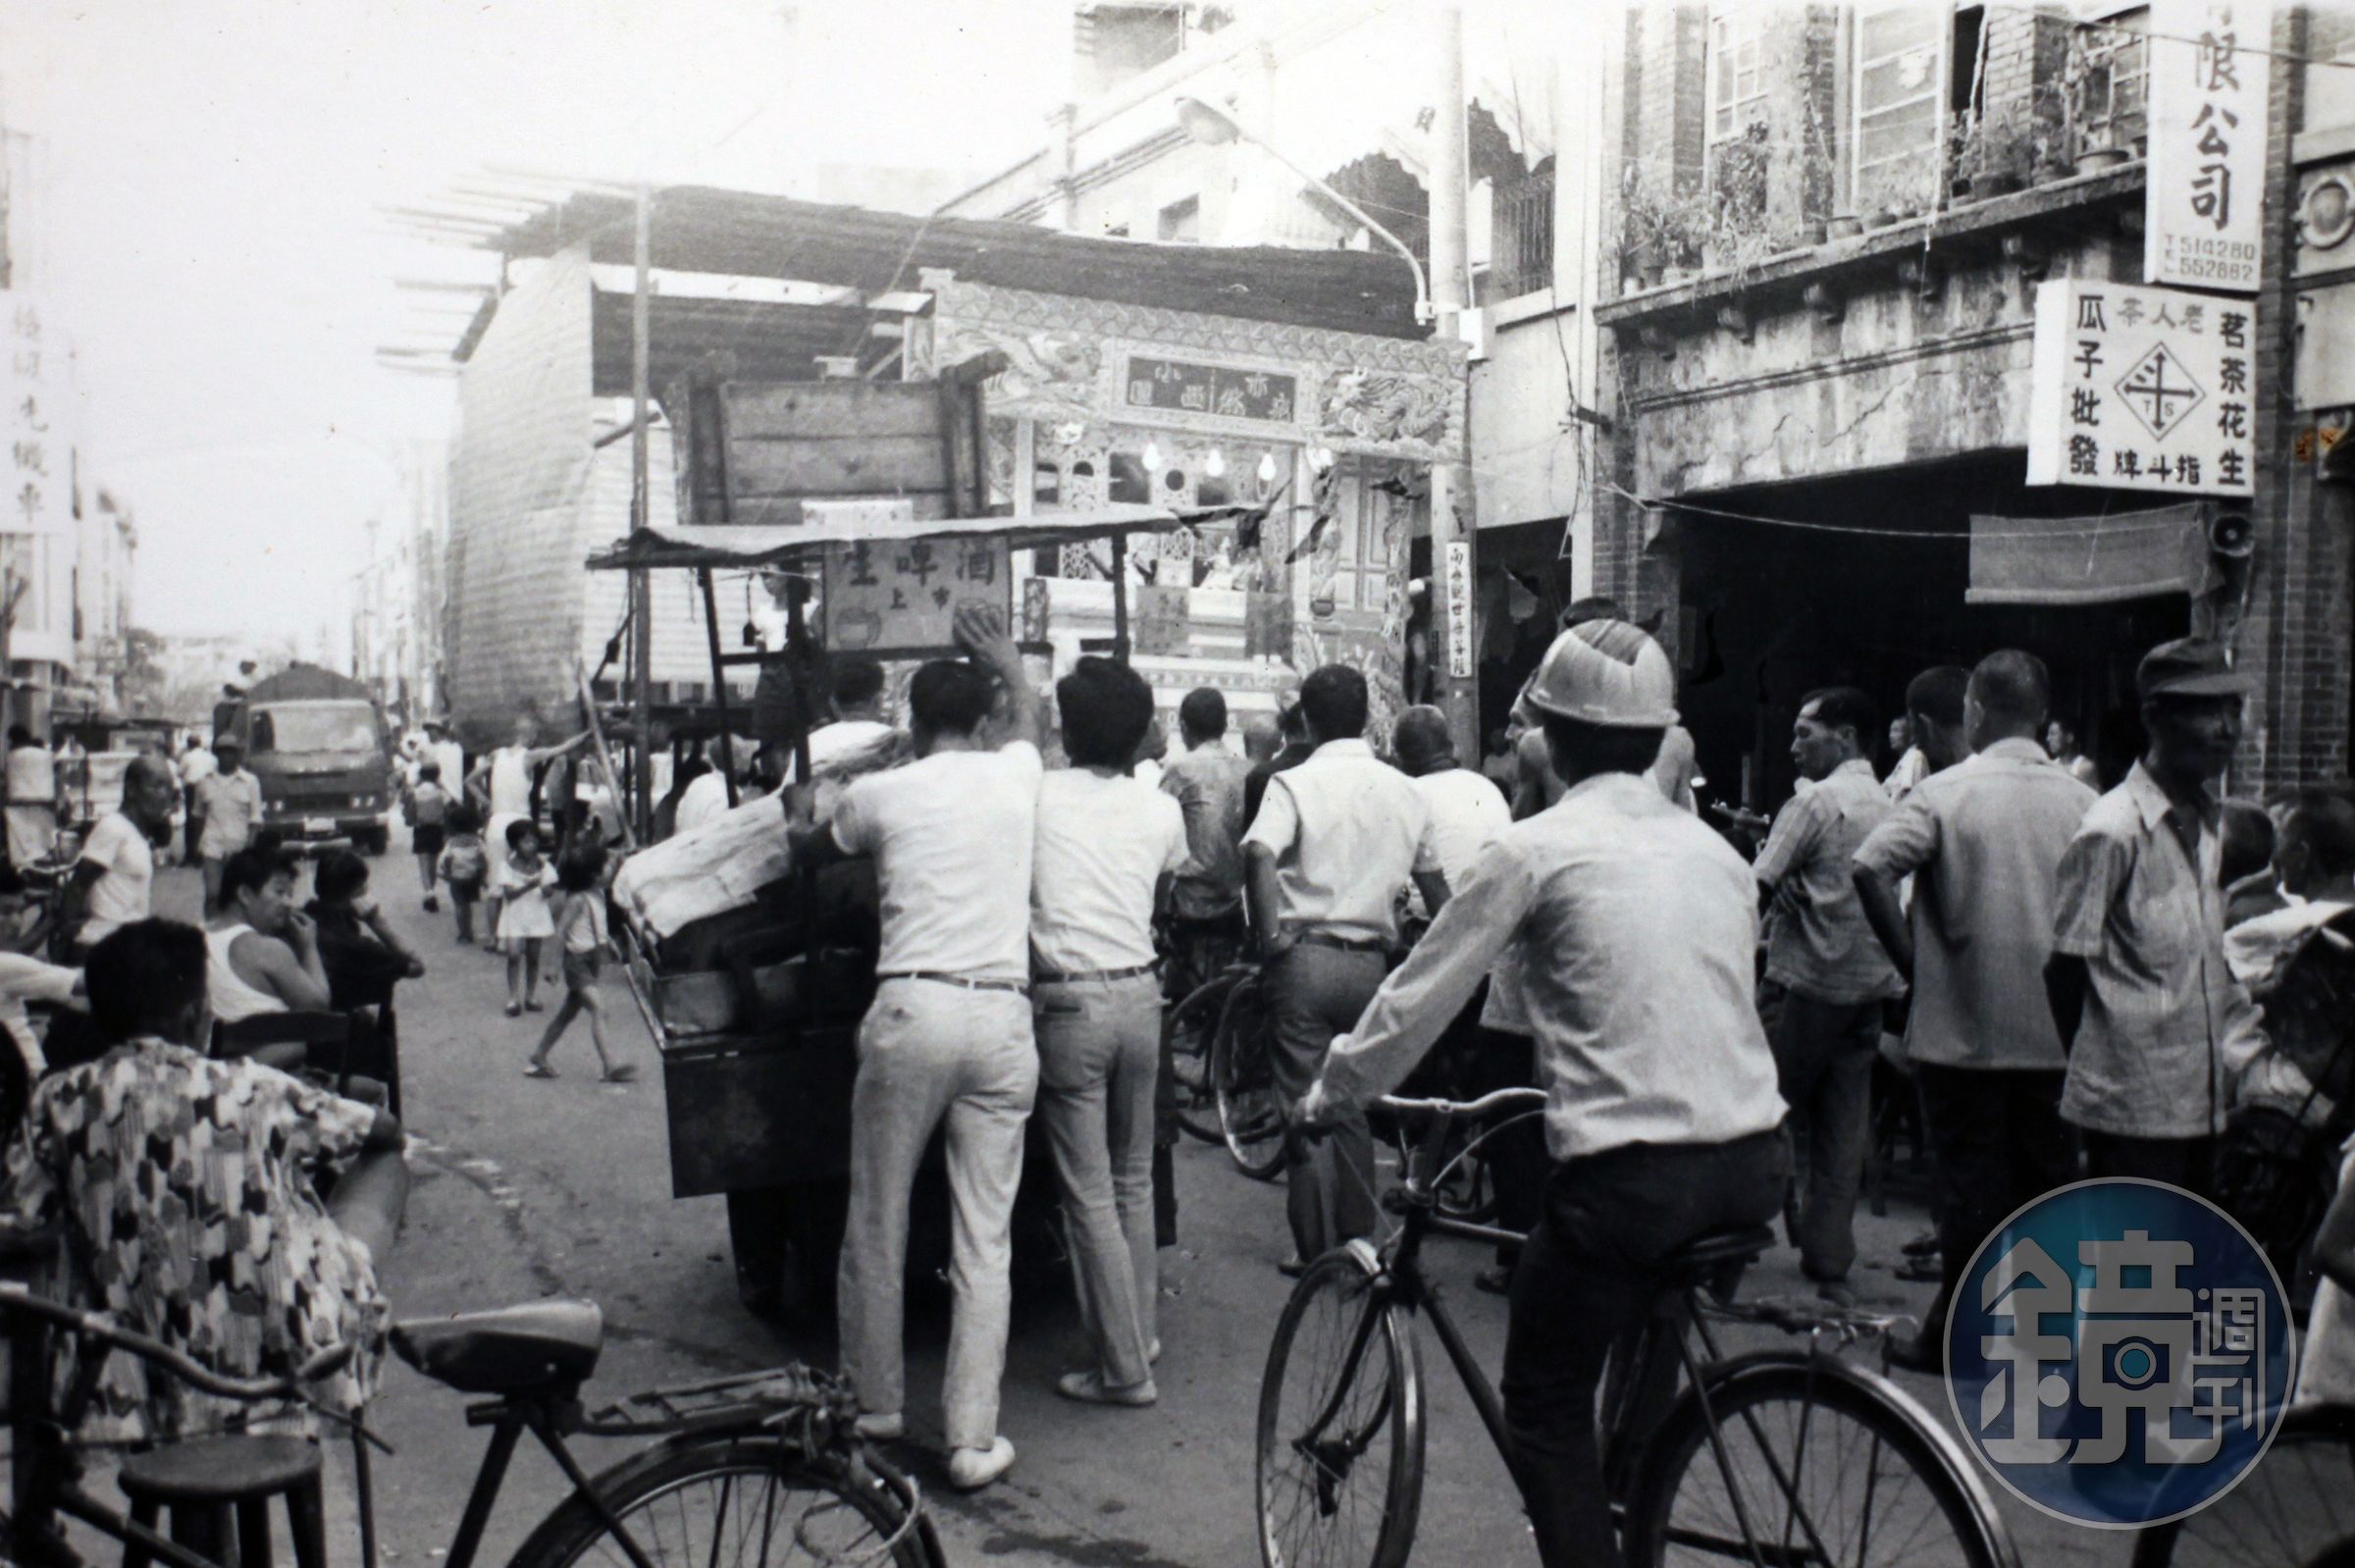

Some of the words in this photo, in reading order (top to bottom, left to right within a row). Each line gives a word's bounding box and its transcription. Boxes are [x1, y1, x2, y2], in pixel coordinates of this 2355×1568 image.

[2068, 293, 2107, 477] 瓜子批發
[2217, 311, 2249, 487] 茗茶花生
